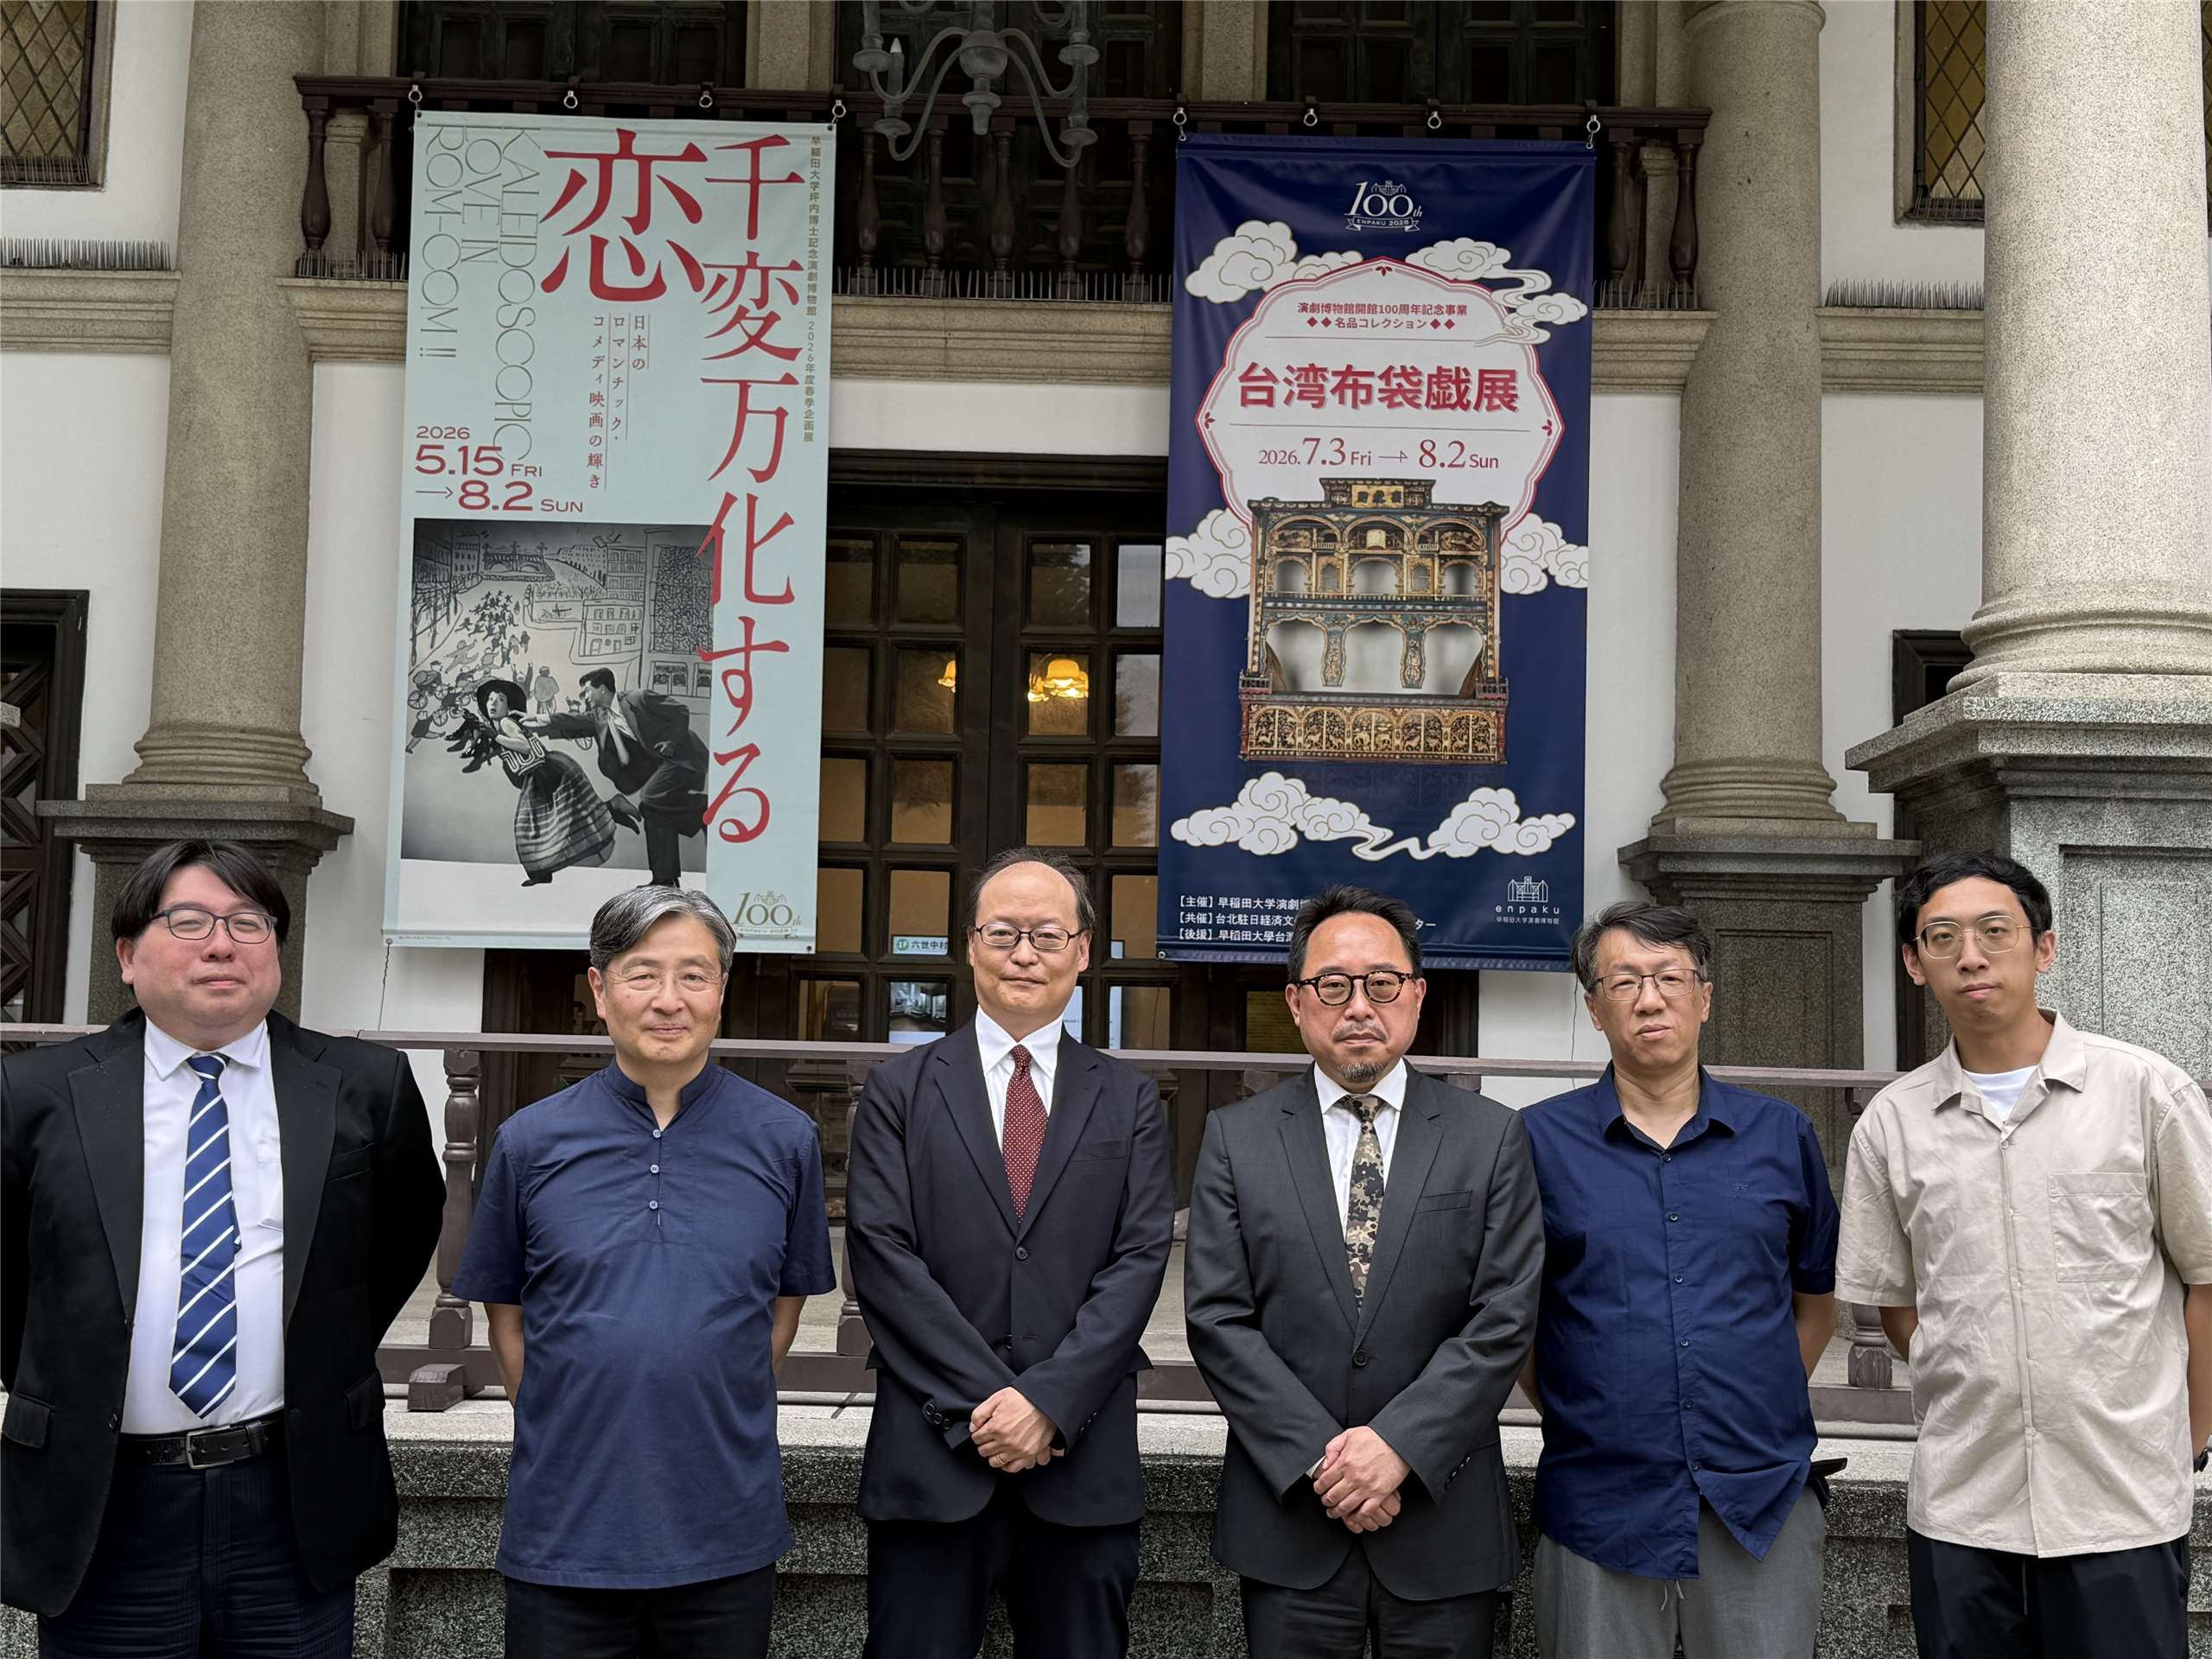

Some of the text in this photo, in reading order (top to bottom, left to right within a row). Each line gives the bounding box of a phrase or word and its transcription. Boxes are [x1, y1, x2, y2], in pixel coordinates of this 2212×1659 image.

[461, 125, 503, 264] LOVE IN
[539, 127, 708, 302] 恋
[493, 126, 542, 461] KALEIDOSCOPIC
[1298, 302, 1468, 316] 演劇博物館開館100周年記念事業
[1335, 317, 1427, 329] 名品コレクション
[632, 315, 647, 371] 日本の
[587, 315, 606, 489] コメディ映画の輝き
[1238, 361, 1520, 413] 台湾布袋戯展
[416, 426, 471, 439] 2026
[415, 444, 543, 477] 5.15 FRI
[1351, 451, 1371, 466] Fri
[1419, 439, 1466, 469] 8.2
[1470, 454, 1499, 469] Sun
[458, 480, 583, 512] 8.2 SUN
[694, 134, 805, 843] 千変万化する
[1179, 912, 1295, 927] 【共催】台北駐日経済文
[1495, 905, 1560, 914] enpaku
